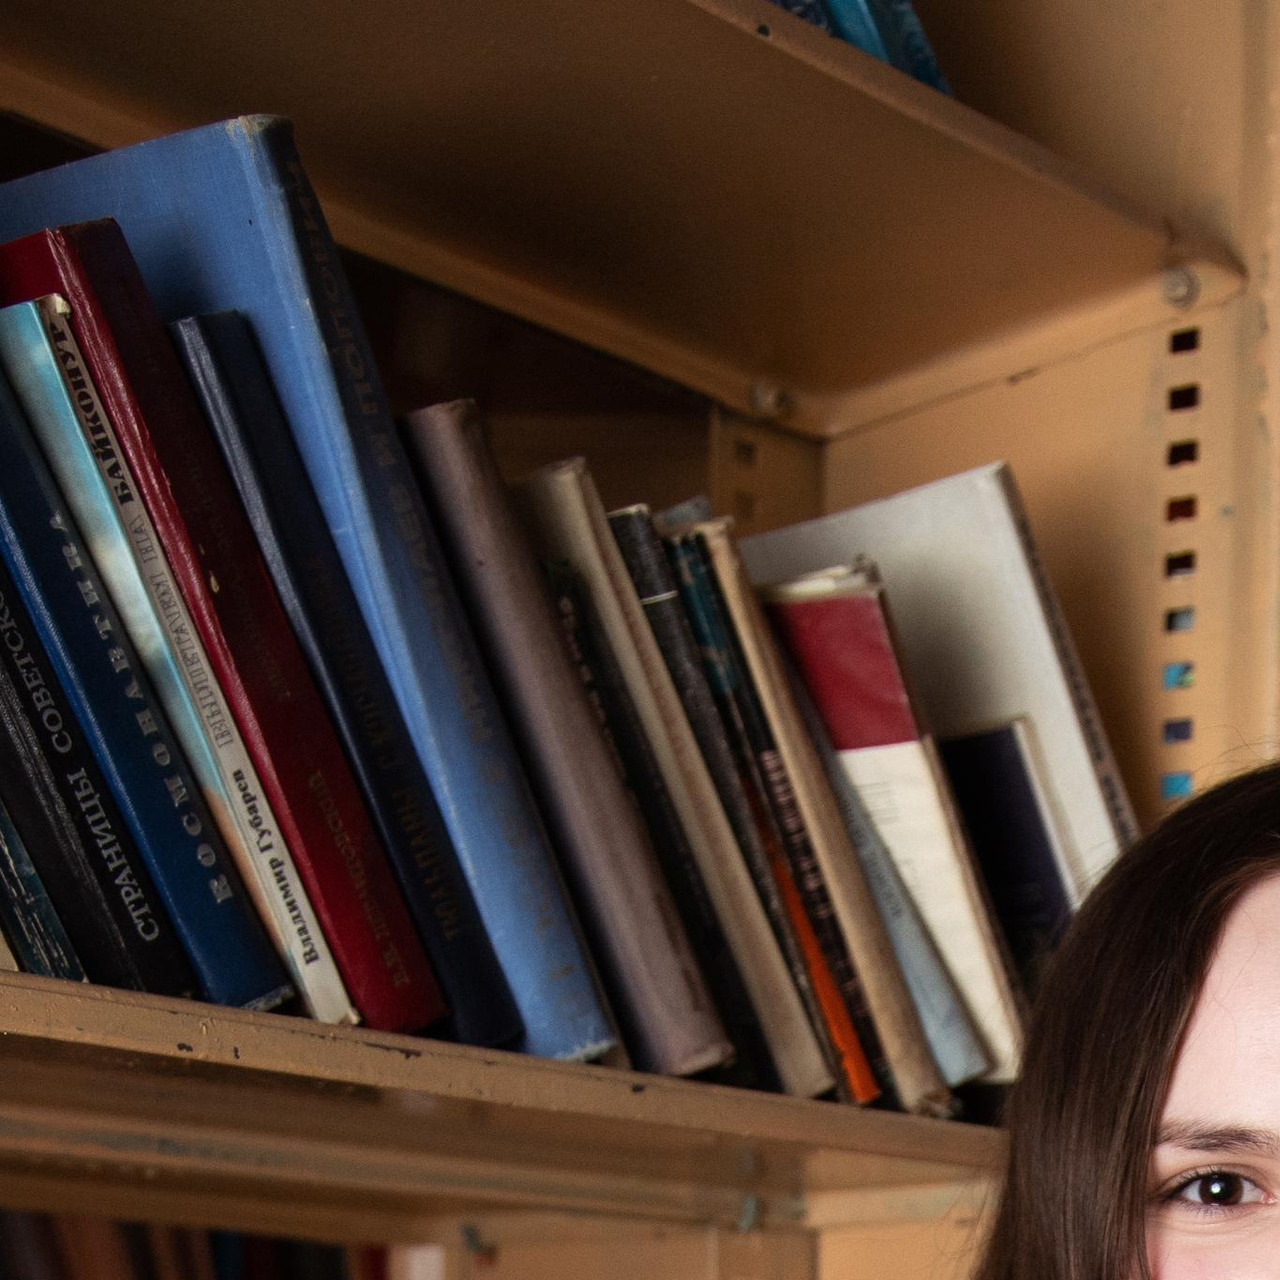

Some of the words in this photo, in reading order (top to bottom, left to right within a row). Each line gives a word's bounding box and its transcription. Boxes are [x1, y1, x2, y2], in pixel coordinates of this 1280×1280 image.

[50, 321, 134, 505] БАЙКОНУР
[0, 591, 73, 753] СОВЕТСК
[50, 511, 232, 903] КОСМОНАВТИКА
[67, 767, 159, 942] СТРАНИЦЫ
[232, 768, 274, 856] Губарев
[269, 857, 320, 965] Владимир
